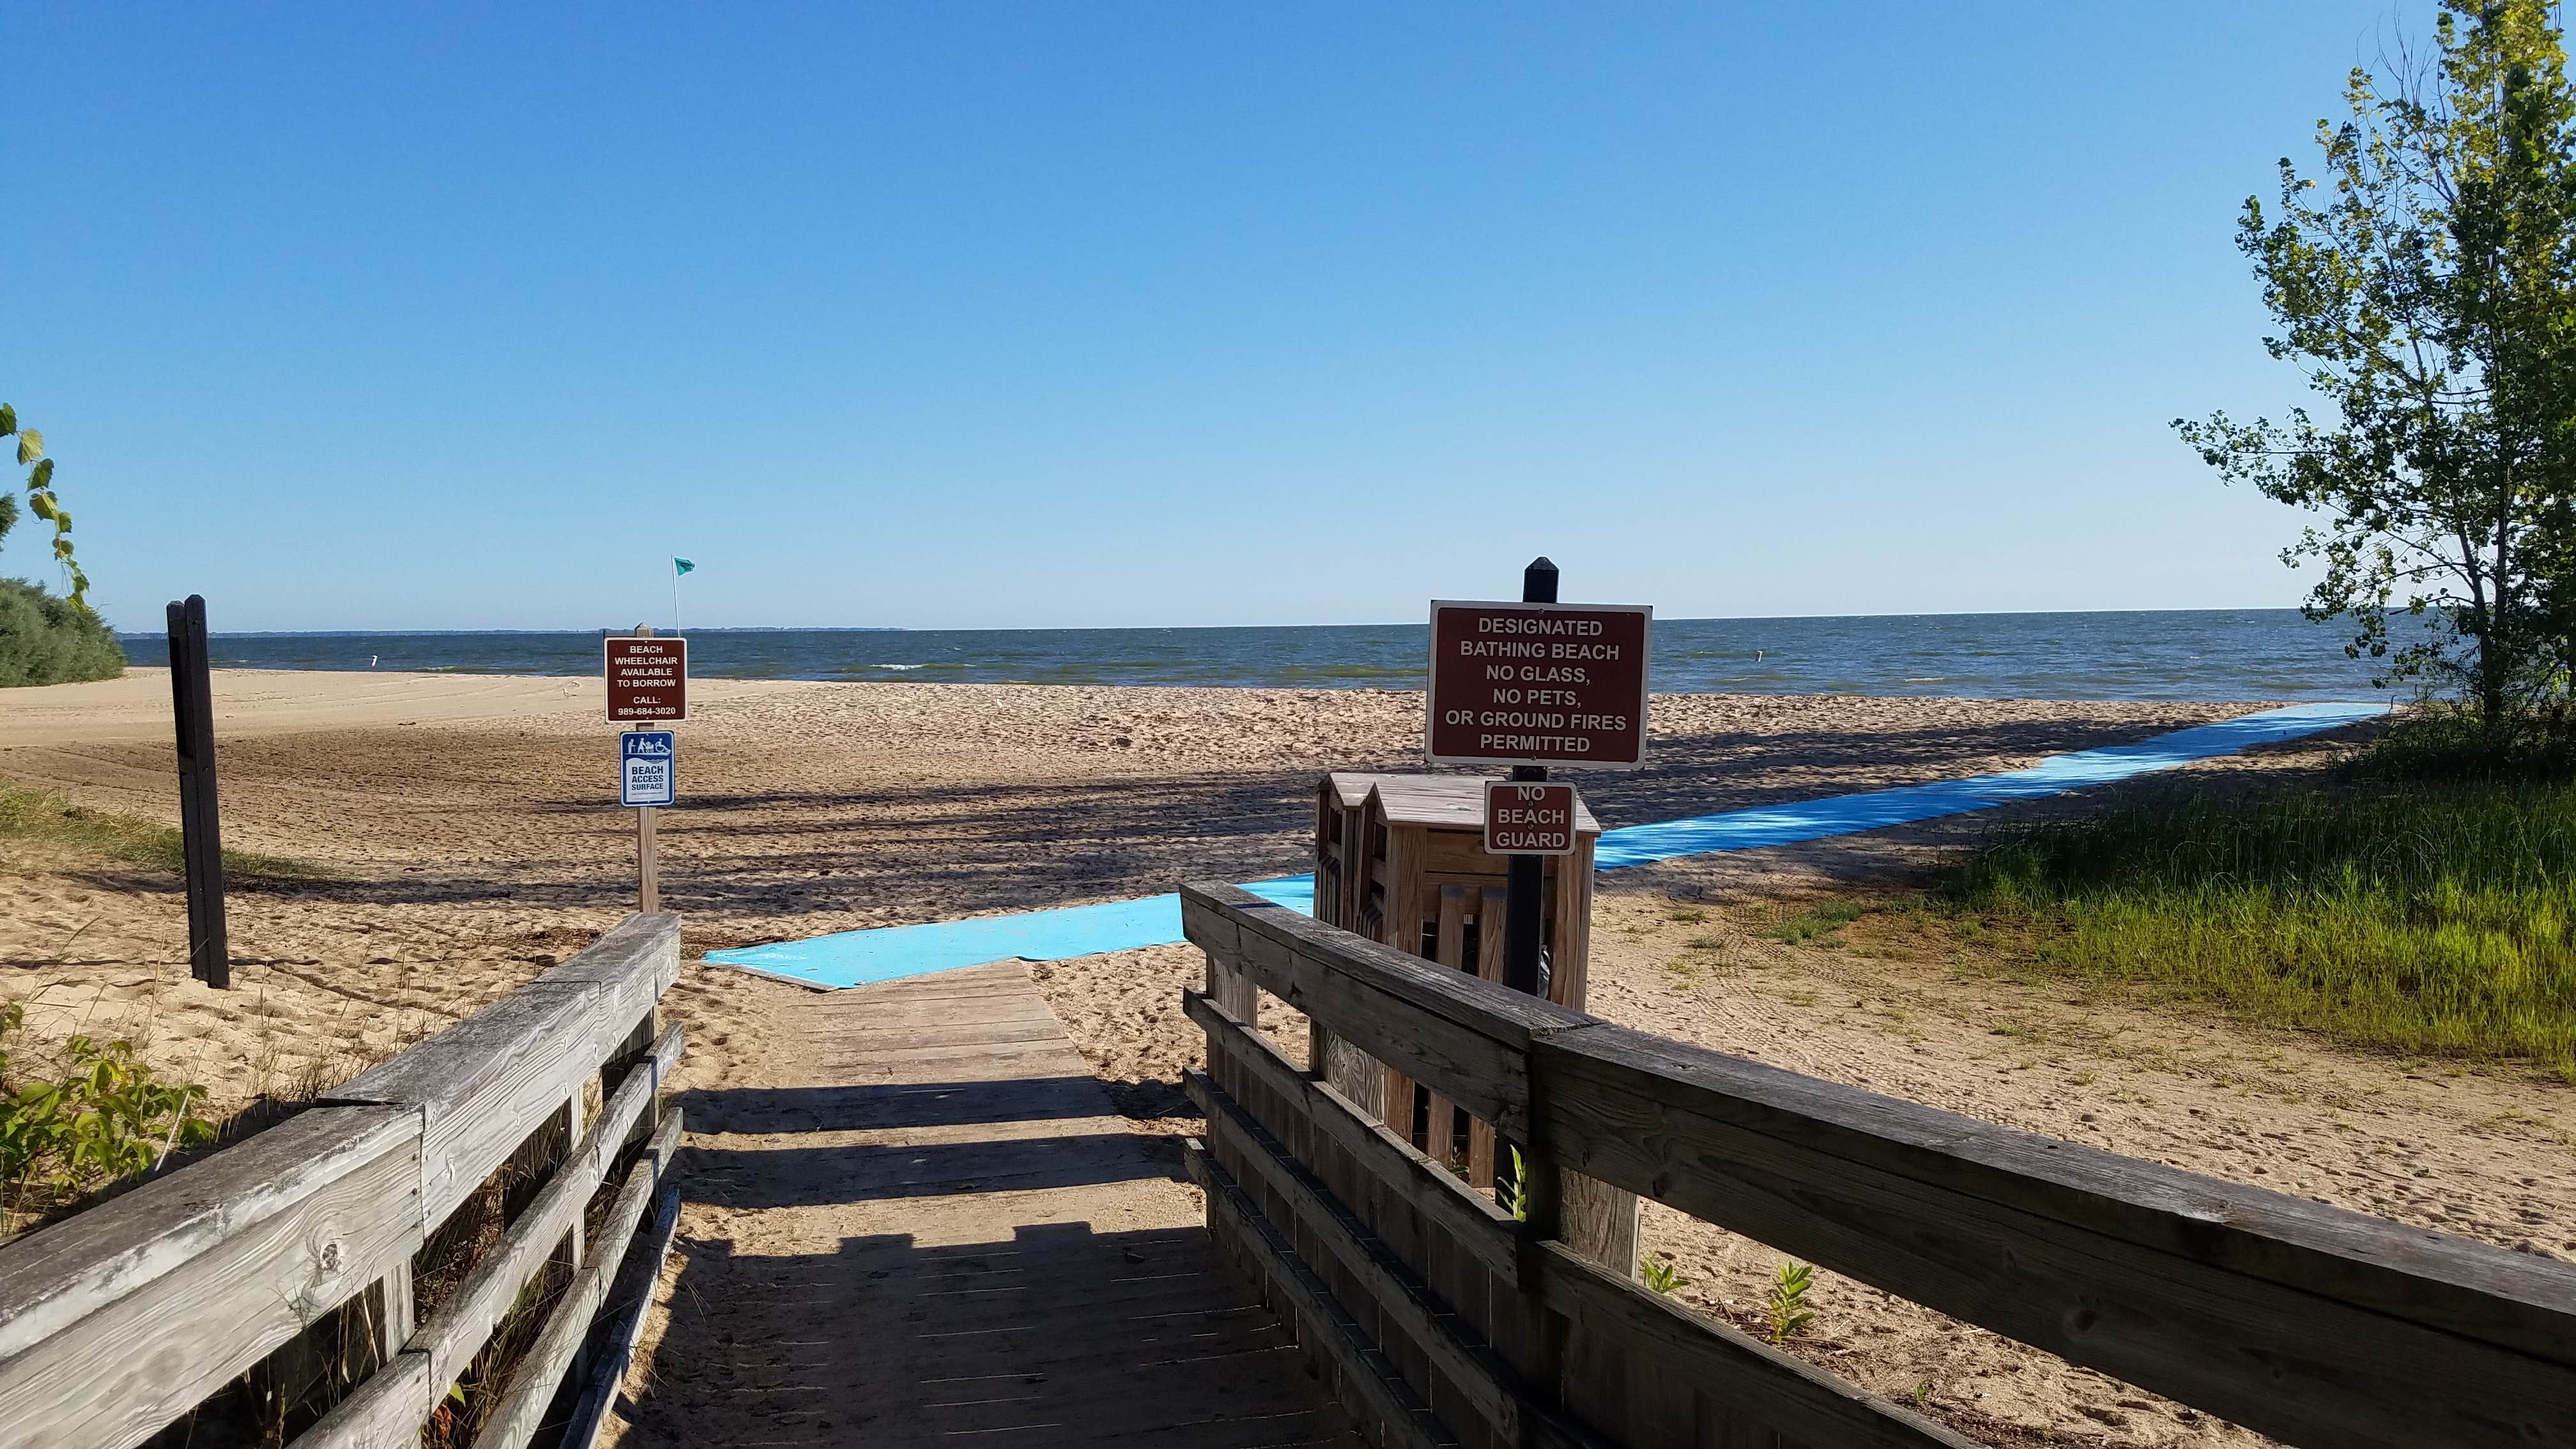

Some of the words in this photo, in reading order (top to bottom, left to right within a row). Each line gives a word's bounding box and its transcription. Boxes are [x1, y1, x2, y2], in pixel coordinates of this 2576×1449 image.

[1478, 617, 1602, 636] DESIGNATED
[1460, 641, 1545, 658] BATHING
[1551, 643, 1619, 661] BEACH
[1486, 664, 1515, 681] NO
[1520, 666, 1590, 686] GLASS,
[1493, 689, 1521, 704] NO
[1527, 689, 1581, 708] PETS,
[1445, 710, 1473, 725] OR
[1480, 711, 1565, 729] GROUND
[1570, 714, 1627, 731] FIRES
[1480, 734, 1590, 752] PERMITTED
[632, 766, 663, 775] BEACH
[1517, 786, 1545, 801] NO
[1498, 809, 1565, 824] BEACH
[1496, 832, 1565, 847] GUARD
